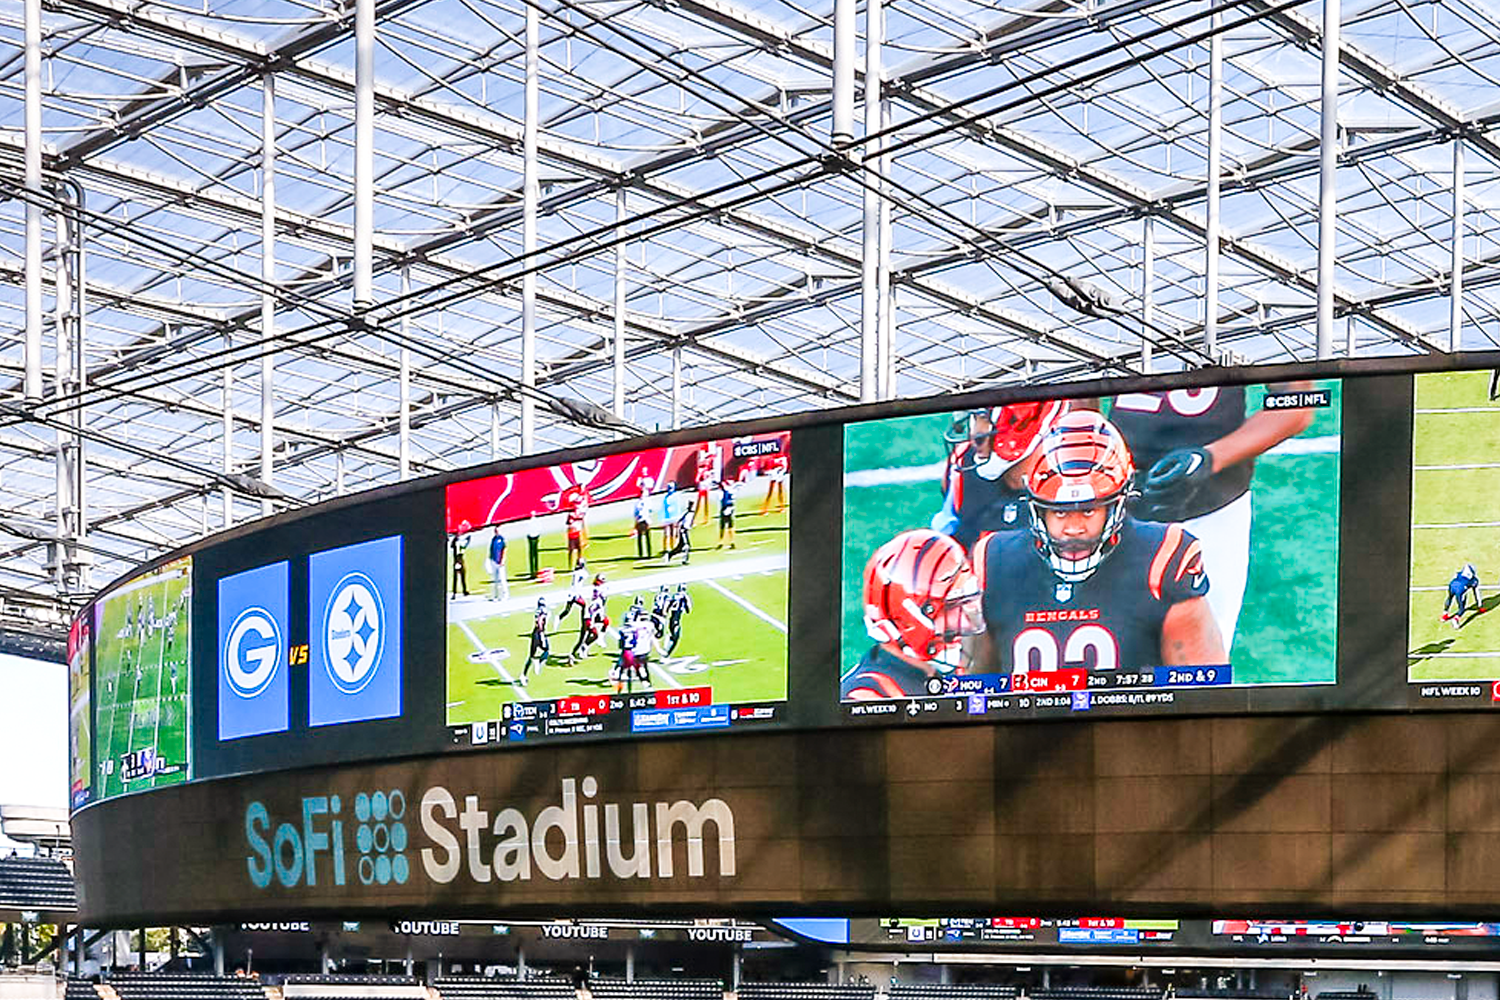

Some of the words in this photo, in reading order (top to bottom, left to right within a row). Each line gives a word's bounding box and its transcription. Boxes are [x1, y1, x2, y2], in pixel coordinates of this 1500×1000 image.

[1276, 394, 1298, 407] CBS
[1303, 393, 1327, 406] NFL
[762, 443, 780, 454] NFL
[1025, 609, 1100, 623] BENGALS
[228, 616, 276, 688] G
[289, 644, 309, 666] VS
[960, 680, 982, 691] HOU
[1000, 677, 1009, 690] 7
[1030, 677, 1048, 688] CIN
[1072, 675, 1080, 686] 7
[1088, 675, 1107, 686] 2ND
[1168, 671, 1193, 684] 2ND
[1195, 670, 1206, 682] &
[1207, 670, 1216, 681] 9
[1421, 687, 1441, 697] NFL
[1442, 687, 1469, 696] WEEK
[1470, 687, 1481, 696] 10
[666, 694, 680, 705] 1ST
[924, 702, 938, 712] NO
[245, 792, 346, 889] SoFi
[420, 776, 737, 884] Stadium
[542, 926, 608, 940] YOUTUBE
[687, 928, 752, 942] YOUTUBE
